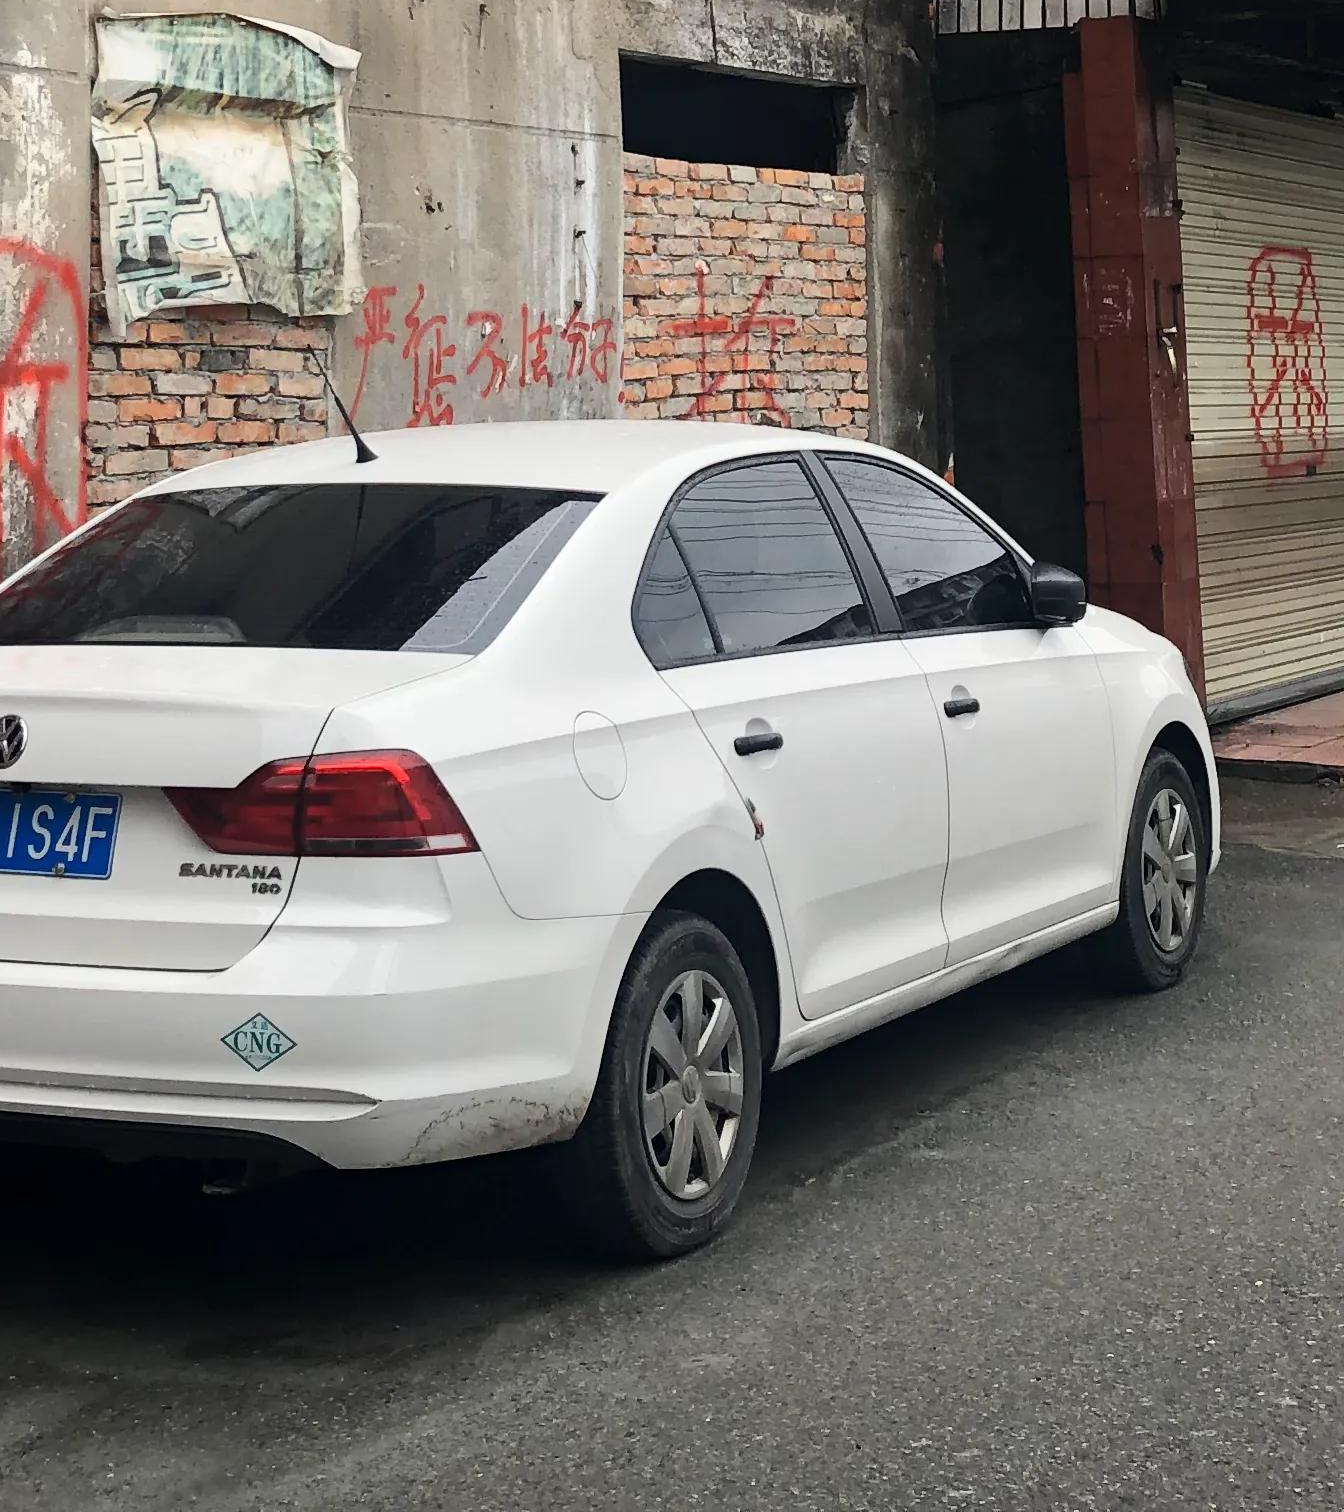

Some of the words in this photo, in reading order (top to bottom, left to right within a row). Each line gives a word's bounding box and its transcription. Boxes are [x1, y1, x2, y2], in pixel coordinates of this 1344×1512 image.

[178, 862, 283, 881] SANTANA
[251, 882, 283, 895] 180
[233, 1030, 283, 1055] CNG
